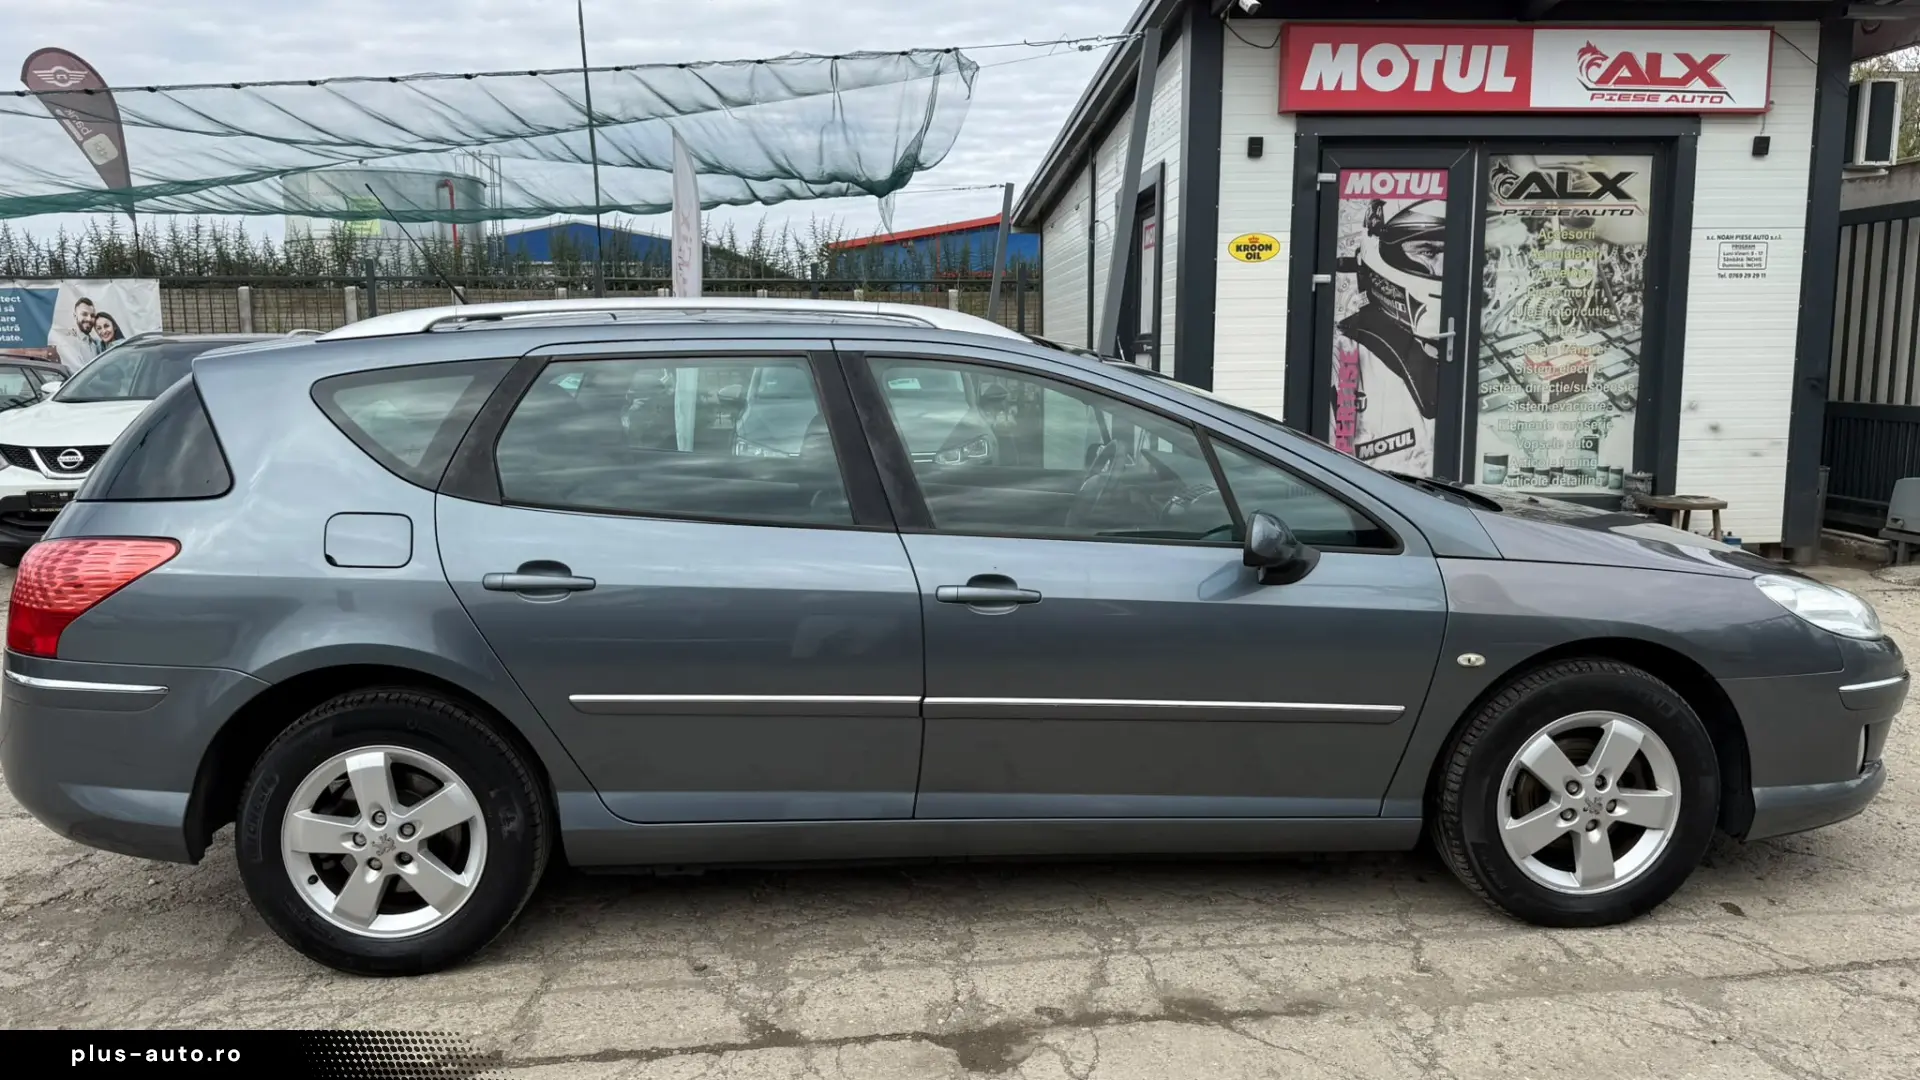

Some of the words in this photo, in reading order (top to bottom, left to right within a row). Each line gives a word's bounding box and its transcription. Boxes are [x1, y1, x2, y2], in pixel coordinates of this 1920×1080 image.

[1300, 43, 1517, 93] MOTUL
[1594, 51, 1730, 89] ALX
[1590, 93, 1660, 103] PIESE
[1665, 95, 1724, 104] AUTO
[1344, 171, 1444, 195] MOTUL
[1506, 171, 1638, 200] ALX
[1502, 208, 1573, 216] PIESE
[1576, 208, 1634, 216] AUTO
[1538, 228, 1595, 240] Accesorii
[1235, 243, 1272, 252] KROON
[1245, 252, 1262, 260] OIL
[1480, 383, 1521, 393] Sistem
[1507, 401, 1548, 412] Sistem
[1359, 432, 1413, 458] MOTUL
[1502, 475, 1548, 486] Articole
